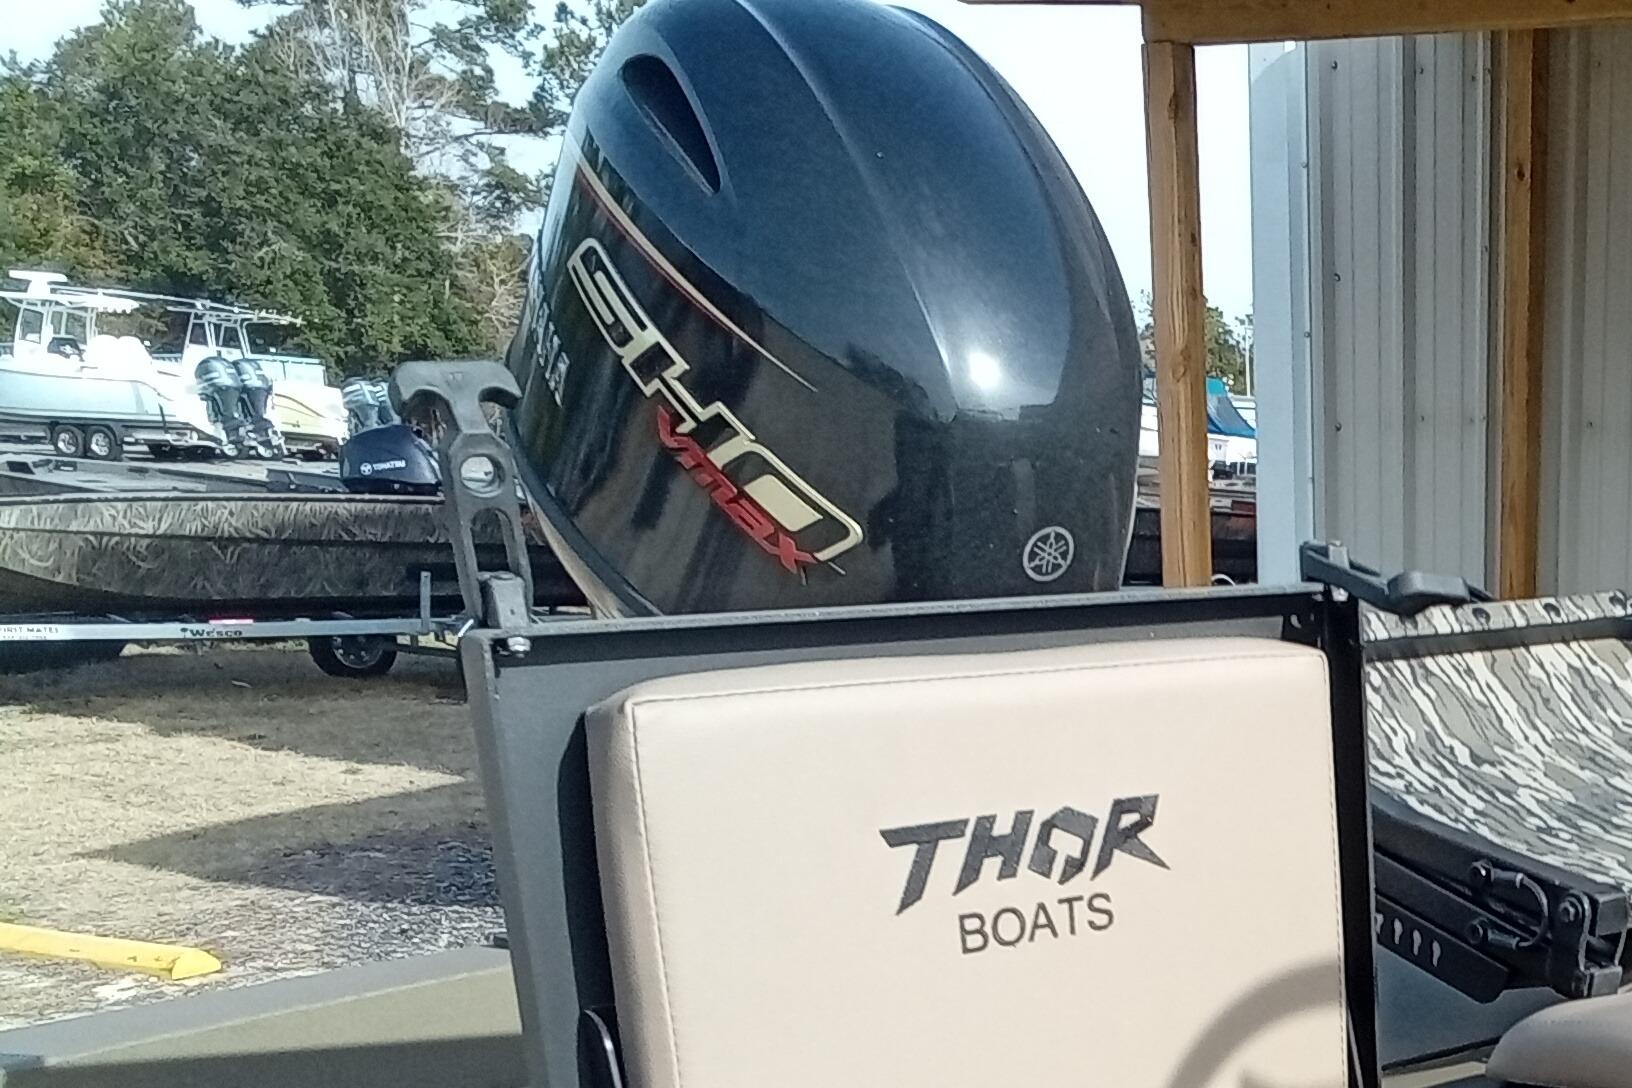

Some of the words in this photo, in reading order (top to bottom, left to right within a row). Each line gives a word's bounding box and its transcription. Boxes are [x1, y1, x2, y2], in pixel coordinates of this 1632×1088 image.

[567, 238, 864, 562] SHO
[879, 794, 1171, 916] THOR
[958, 893, 1114, 954] BOATS
